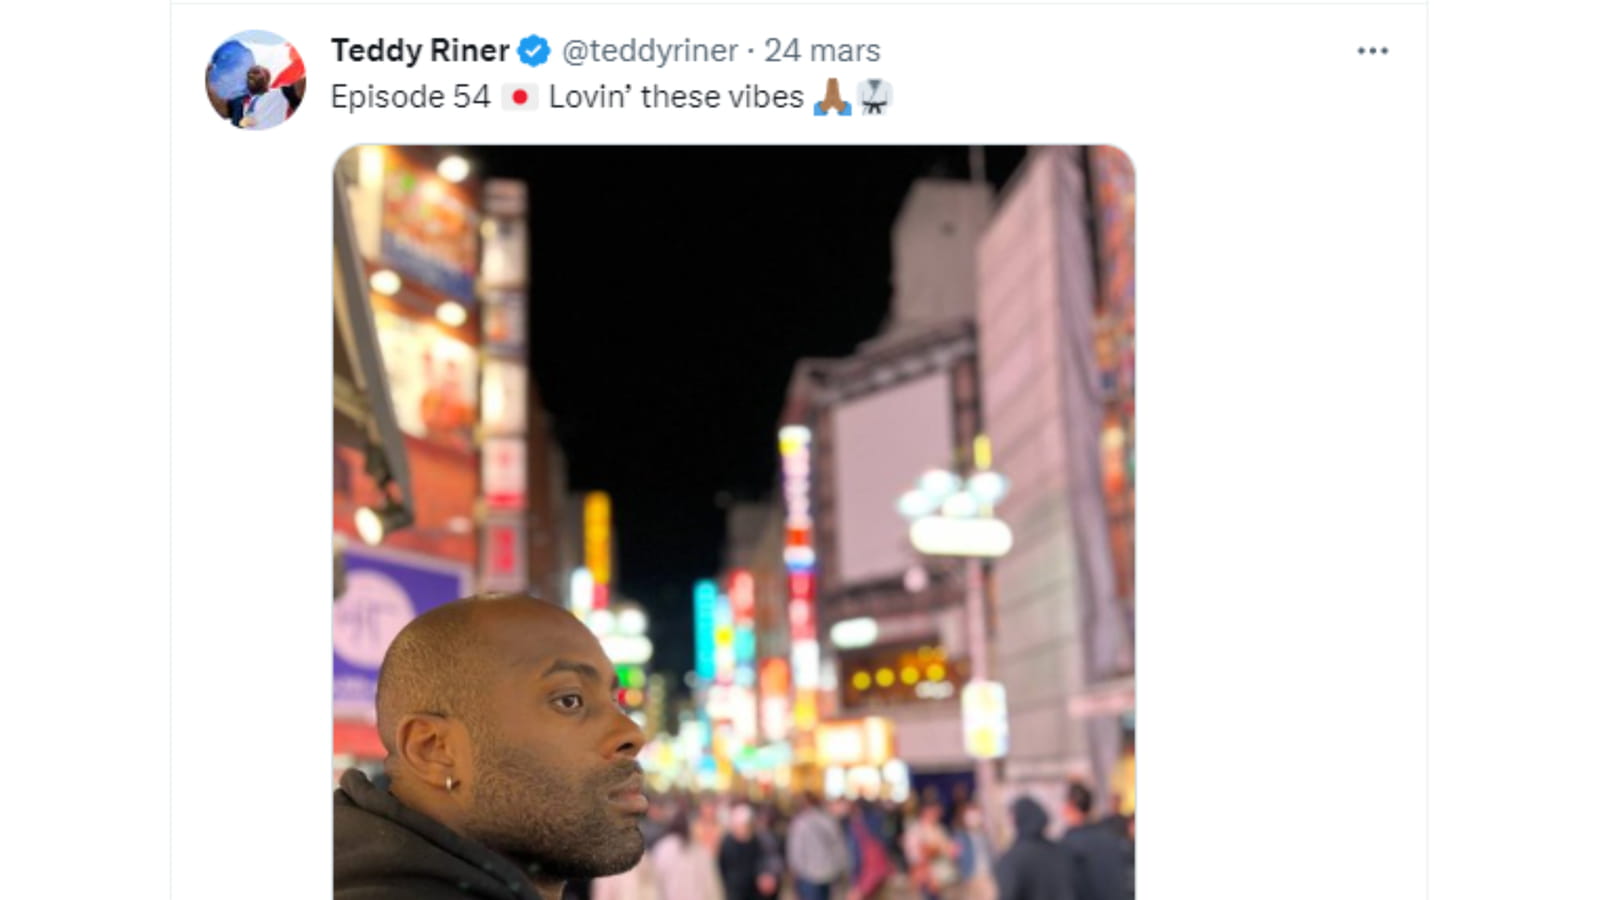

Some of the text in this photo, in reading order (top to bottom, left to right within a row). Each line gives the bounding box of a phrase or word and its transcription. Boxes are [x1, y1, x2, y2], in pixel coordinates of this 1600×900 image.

[331, 37, 881, 69] Teddy Riner @teddyriner 24 mars
[331, 83, 805, 115] Episode 54 Lovin’ these vibes
